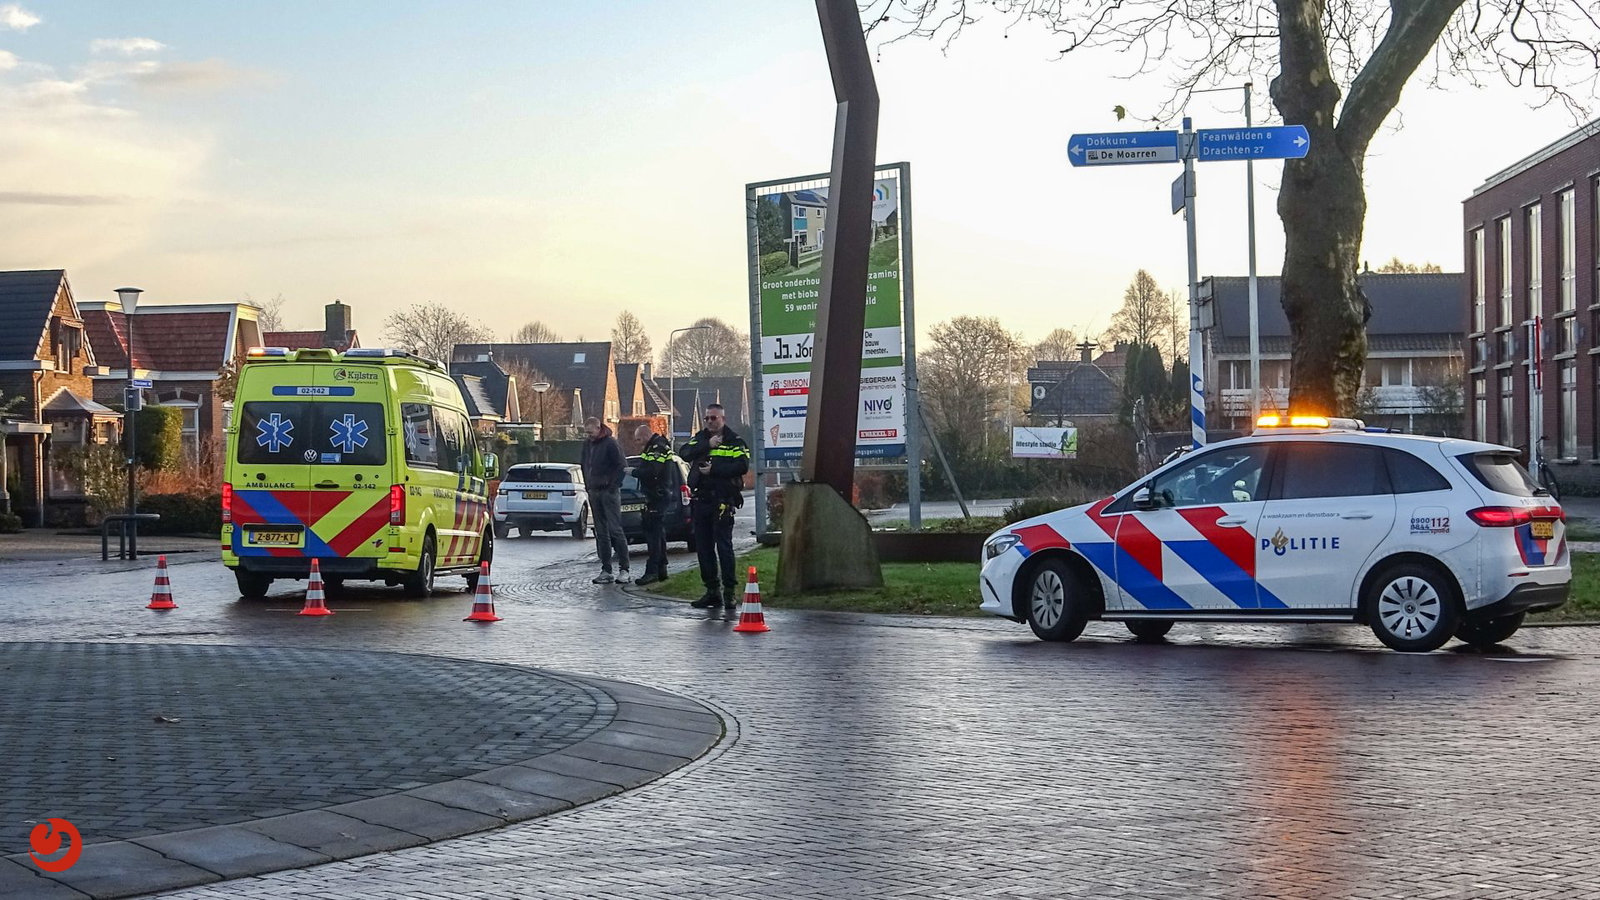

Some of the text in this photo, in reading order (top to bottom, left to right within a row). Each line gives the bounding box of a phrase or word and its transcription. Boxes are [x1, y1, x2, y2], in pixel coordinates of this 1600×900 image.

[1086, 137, 1128, 146] Dokkum
[1202, 132, 1272, 142] Feanwâlden 8
[1101, 150, 1157, 159] De Moarren
[1203, 146, 1251, 155] Drachten
[762, 280, 783, 290] Groot
[781, 291, 796, 300] met
[785, 304, 795, 312] 59
[347, 371, 379, 380] Kijlstra
[782, 379, 809, 388] SIMSON
[864, 398, 892, 411] NIVO
[1431, 517, 1449, 528] 112
[257, 533, 295, 541] Z-877-KT
[1261, 537, 1340, 557] POLITIE
